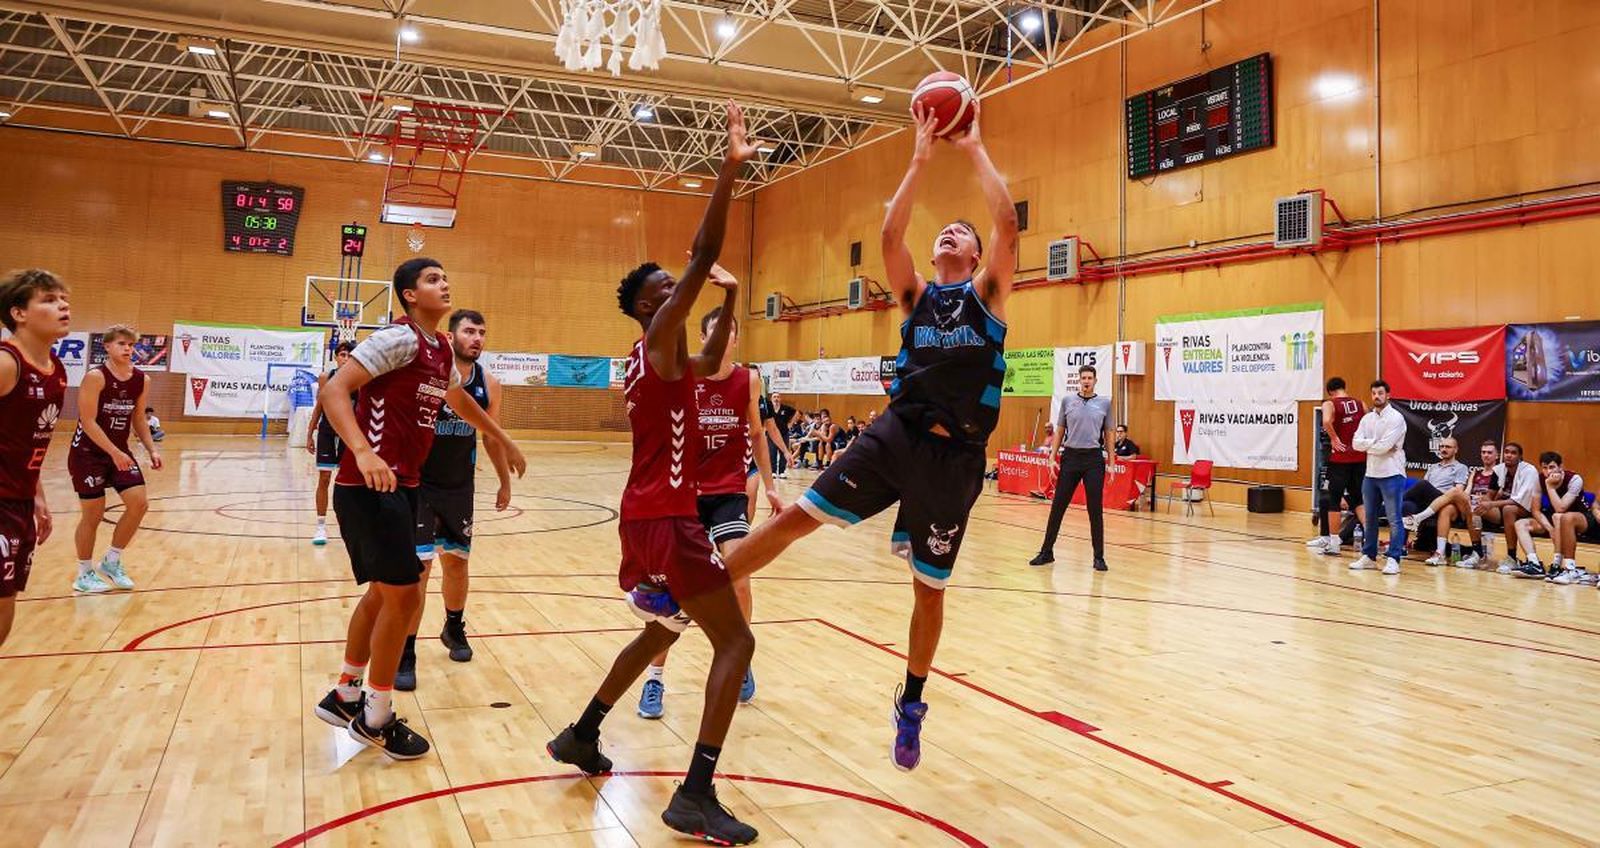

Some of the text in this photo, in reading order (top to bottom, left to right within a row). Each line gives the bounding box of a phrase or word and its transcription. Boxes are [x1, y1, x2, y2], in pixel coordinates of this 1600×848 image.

[1158, 108, 1178, 121] LOCAL
[236, 194, 293, 211] 81 4 58
[244, 215, 277, 230] 05:38
[232, 235, 240, 245] 4
[278, 238, 287, 249] 2
[343, 239, 362, 252] 24
[202, 335, 230, 345] RIVAS
[1183, 335, 1210, 348] RIVAS
[201, 343, 241, 352] ENTRENA
[1231, 342, 1272, 352] PLAN CONTRA
[200, 350, 241, 360] VALORES
[1183, 349, 1222, 361] ENTRENA
[1241, 353, 1270, 362] VIOLENCIA
[1408, 350, 1482, 366] VIPS
[1567, 345, 1600, 369] Vib
[1183, 361, 1223, 373] VALORES
[1231, 365, 1240, 373] EN
[1249, 363, 1275, 372] DEPORTE
[850, 366, 879, 382] Cazorla
[1423, 370, 1465, 380] Muy abierto
[210, 380, 238, 389] RIVAS
[1341, 400, 1358, 415] 10
[1409, 400, 1478, 411] Uros de Rivas
[698, 408, 734, 416] ZENTRO
[109, 416, 128, 430] 15
[1199, 413, 1294, 425] RIVAS VACIAMADRID
[703, 433, 729, 450] 16
[999, 452, 1015, 462] RIVAS
[999, 464, 1029, 478] Deportes
